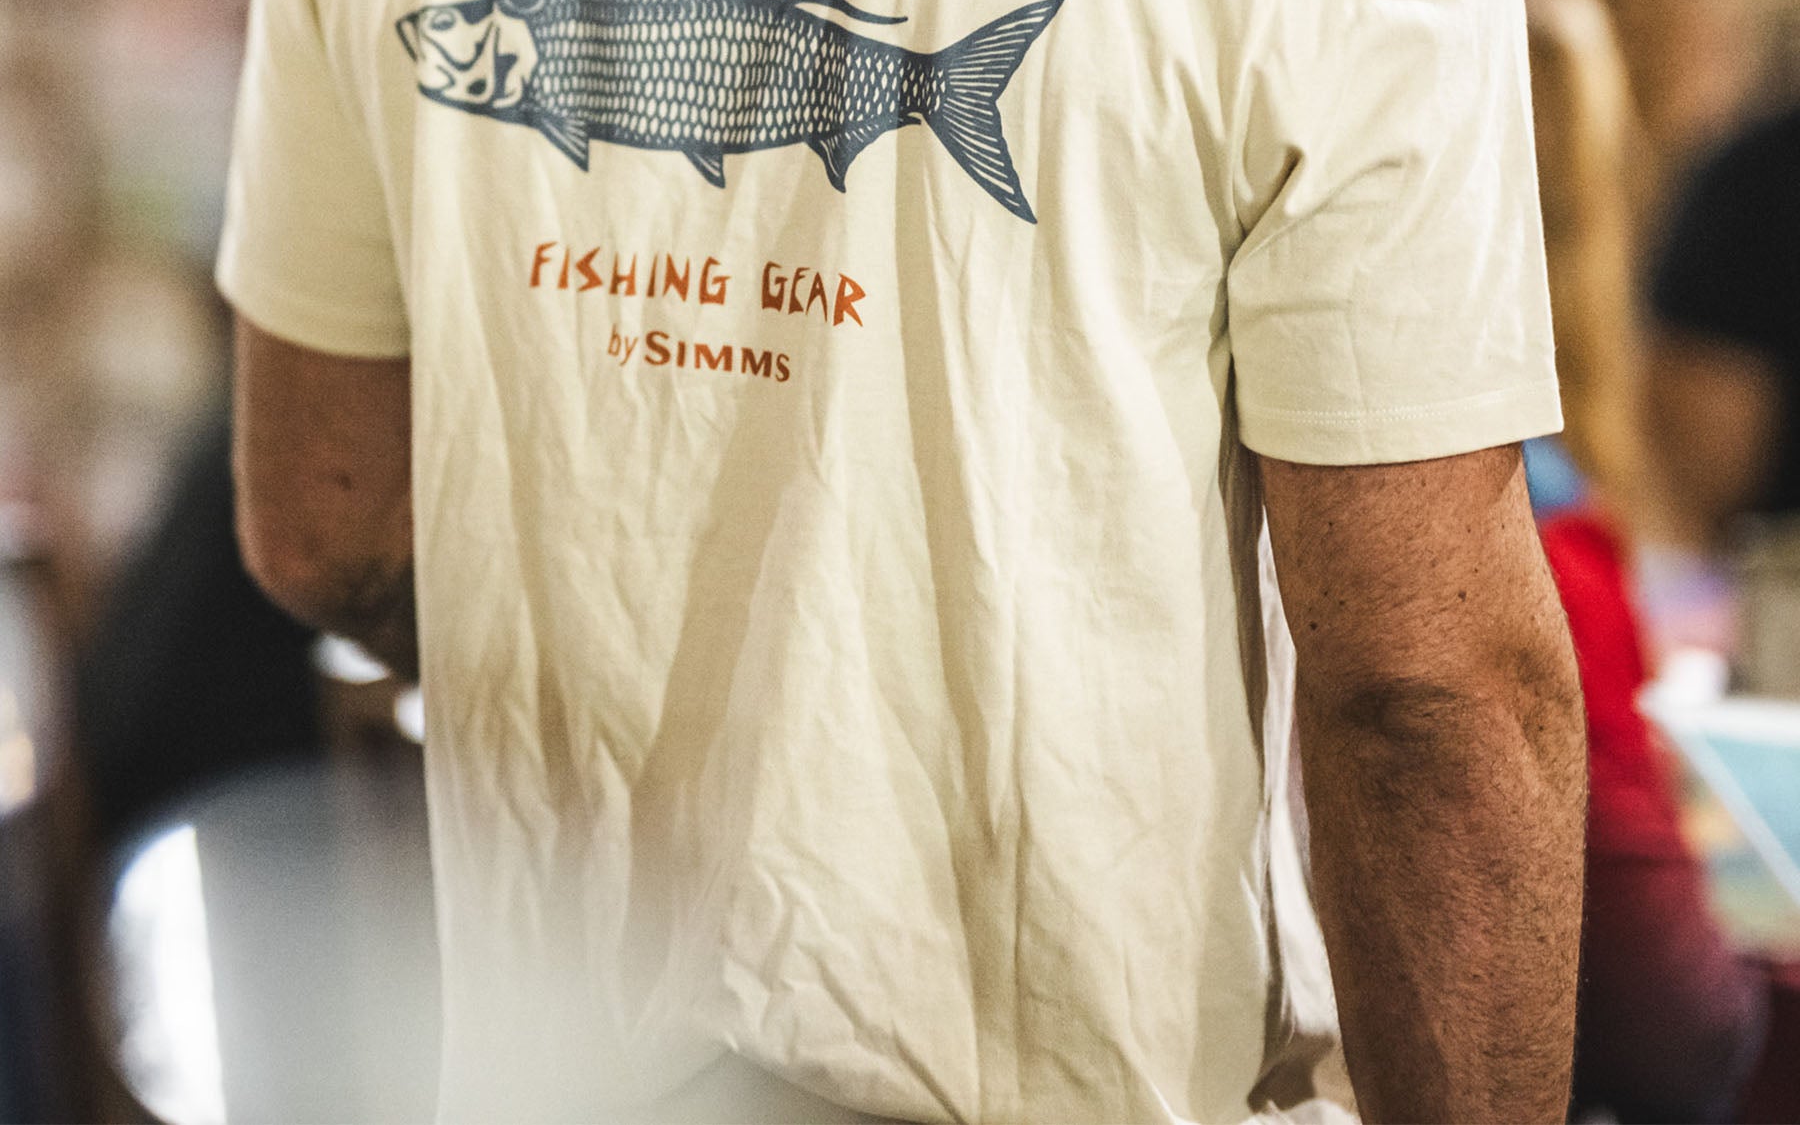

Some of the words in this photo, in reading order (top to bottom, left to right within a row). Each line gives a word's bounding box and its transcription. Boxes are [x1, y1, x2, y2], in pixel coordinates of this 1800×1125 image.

[529, 241, 731, 306] FISHING
[761, 261, 866, 327] GEAR
[608, 325, 638, 366] by
[644, 330, 791, 383] SIMMS
